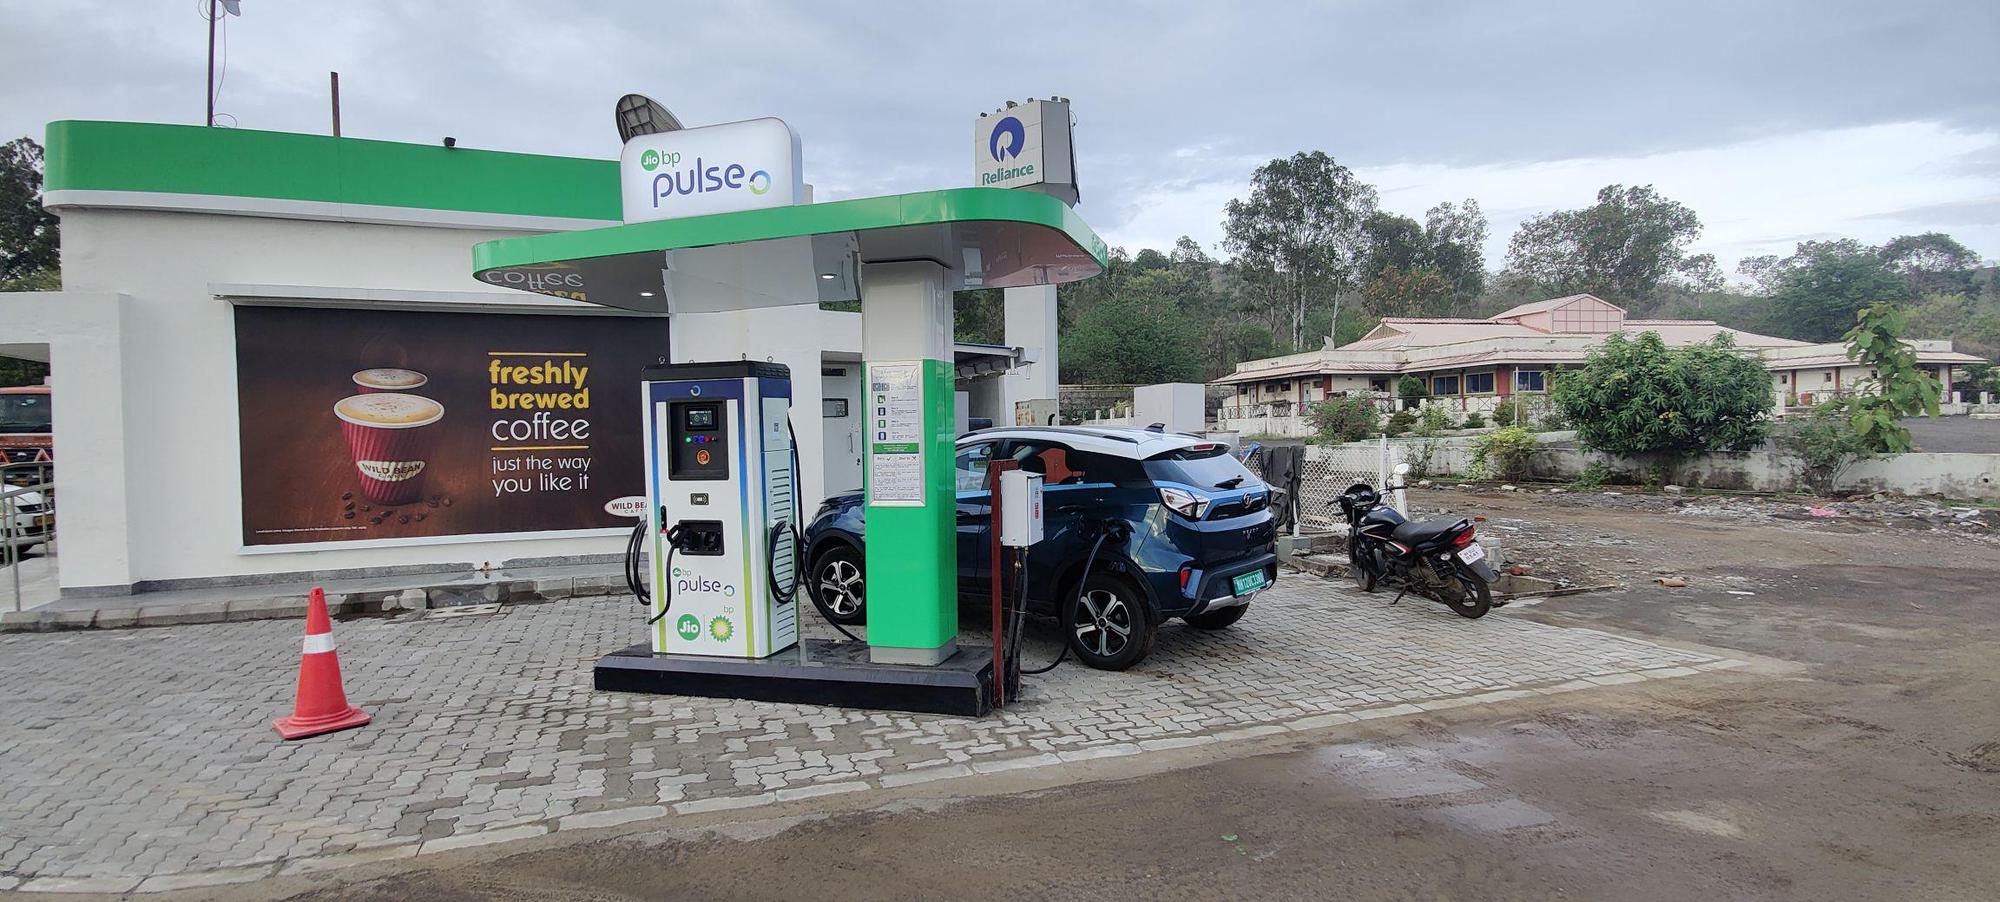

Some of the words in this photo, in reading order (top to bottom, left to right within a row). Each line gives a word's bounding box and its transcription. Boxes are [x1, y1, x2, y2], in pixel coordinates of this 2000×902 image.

[643, 155, 658, 166] Jio
[661, 150, 681, 168] bp
[652, 157, 745, 208] pulse
[982, 164, 1034, 185] Reliance
[489, 359, 589, 389] freshly
[490, 387, 590, 409] brewed
[491, 411, 590, 441] coffee
[362, 463, 390, 475] WILD
[393, 463, 420, 474] BEAN
[492, 456, 521, 474] just
[526, 455, 553, 470] the
[558, 457, 591, 471] way
[492, 478, 532, 497] you
[539, 472, 572, 491] like
[579, 473, 589, 490] it
[611, 502, 633, 510] WILD
[678, 575, 721, 595] pulse
[723, 605, 734, 615] bp
[679, 620, 699, 634] Jio
